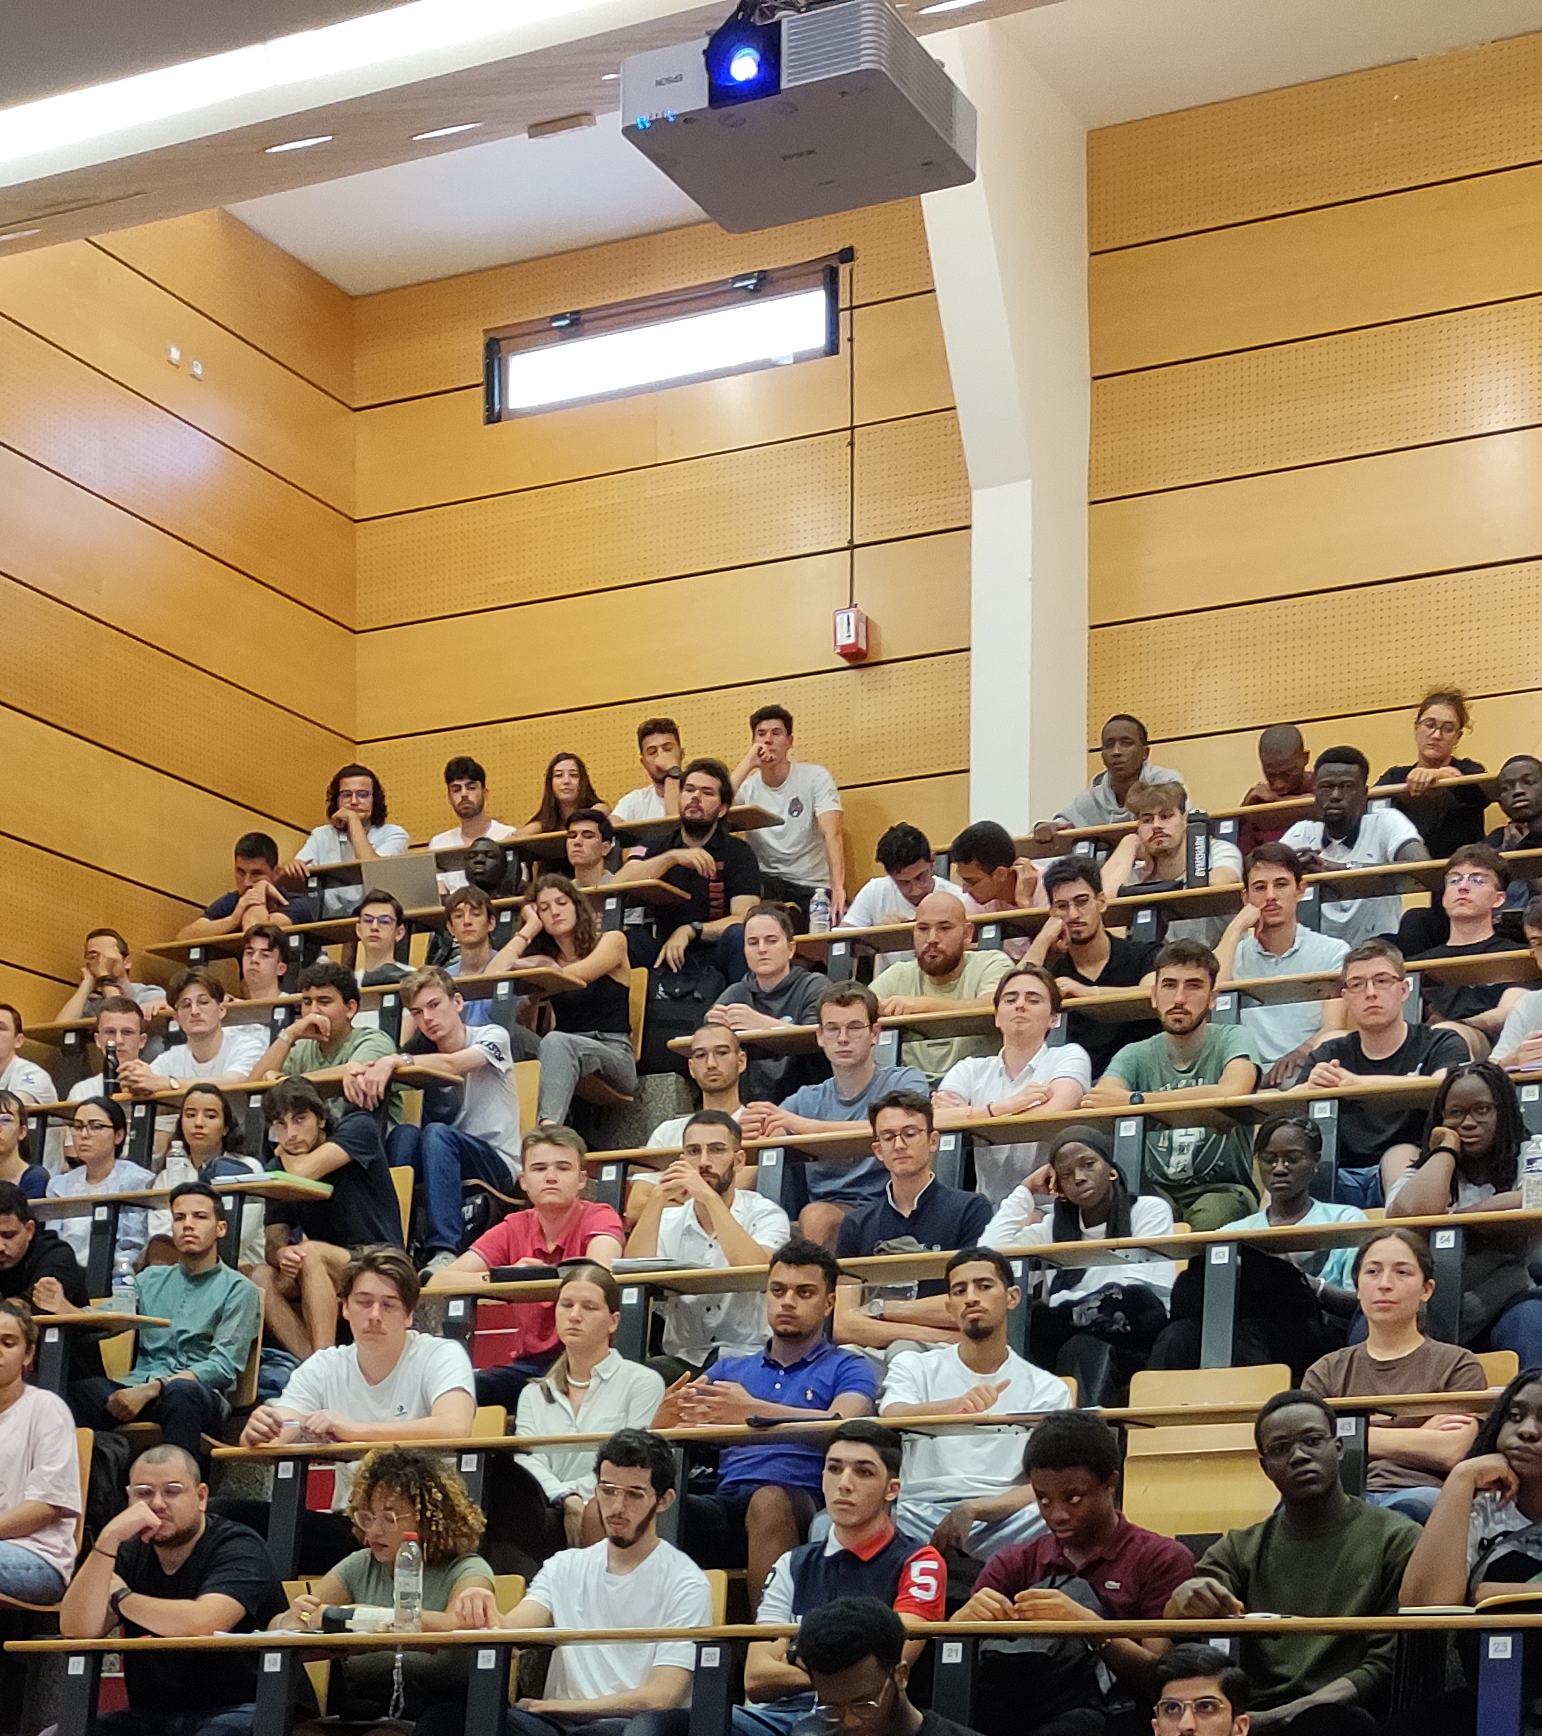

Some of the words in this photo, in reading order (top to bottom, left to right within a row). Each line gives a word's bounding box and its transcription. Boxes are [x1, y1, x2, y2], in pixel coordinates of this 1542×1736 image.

[909, 1561, 939, 1601] 5
[947, 1647, 959, 1658] 21
[1493, 1641, 1508, 1653] 23
[704, 1652, 717, 1662] 20
